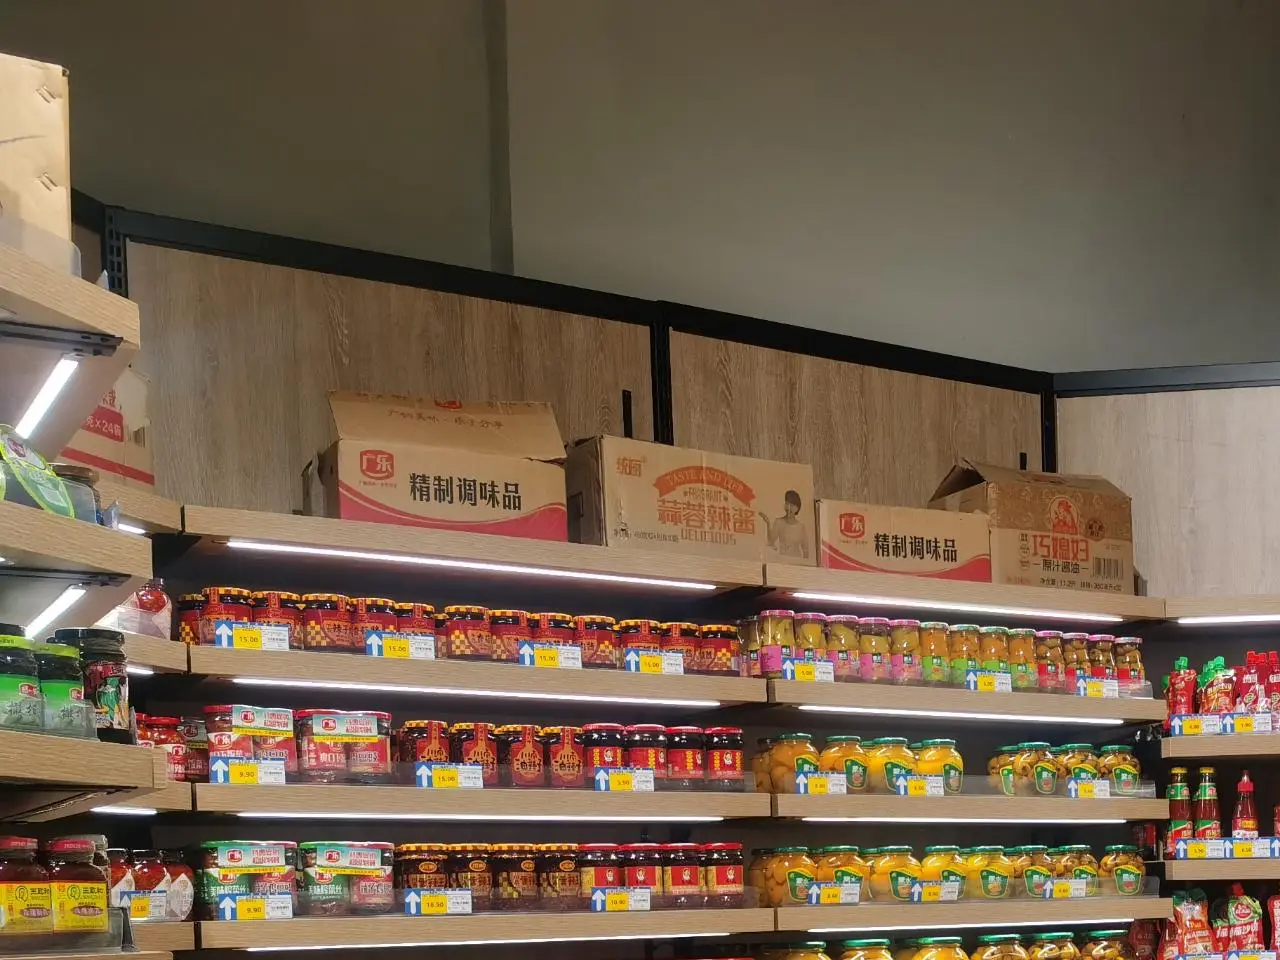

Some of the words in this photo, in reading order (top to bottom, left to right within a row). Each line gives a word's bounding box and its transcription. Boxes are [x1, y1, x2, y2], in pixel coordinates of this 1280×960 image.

[409, 472, 522, 511] 精制调味品
[874, 533, 957, 562] 精制调味品
[1032, 535, 1089, 562] 巧媳妇
